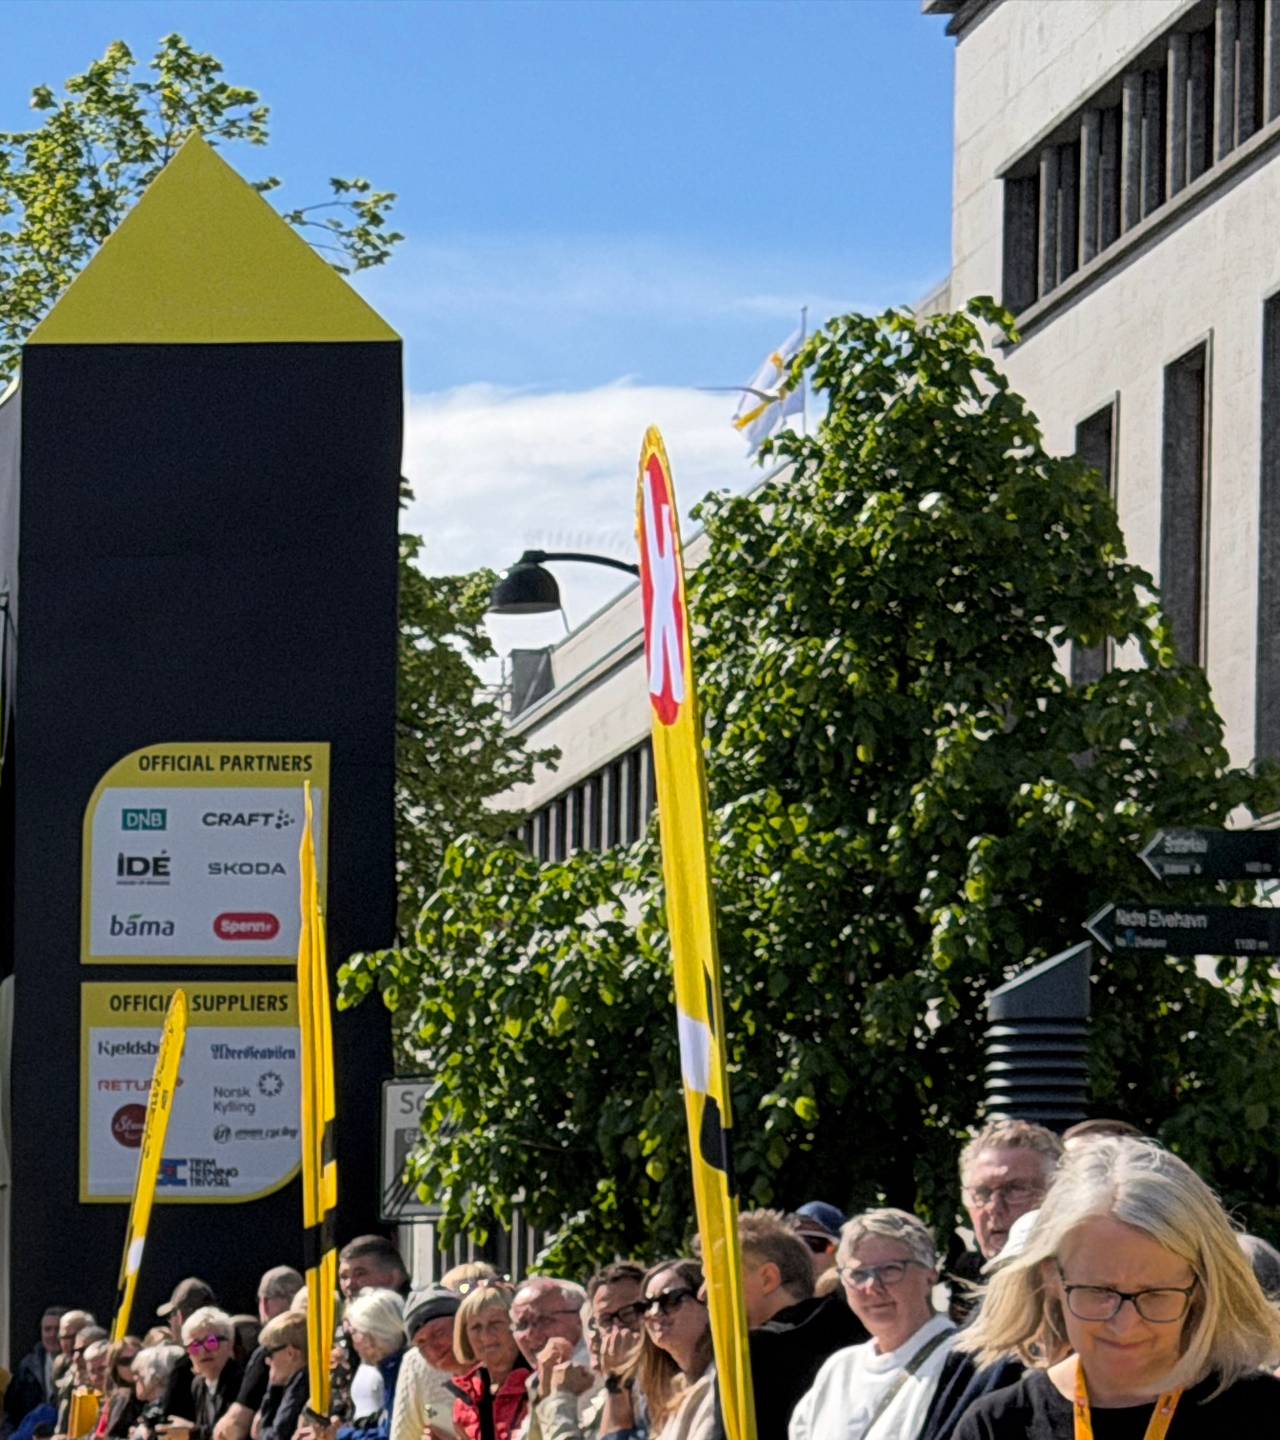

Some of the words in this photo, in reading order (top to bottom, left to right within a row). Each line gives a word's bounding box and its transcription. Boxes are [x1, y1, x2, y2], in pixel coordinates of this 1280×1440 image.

[138, 755, 215, 772] OFFICIAL
[219, 755, 313, 772] PARTNERS
[126, 812, 163, 828] DNB
[202, 811, 274, 827] CRAFT
[109, 995, 171, 1011] OFFICI
[191, 995, 289, 1011] SUPPLIERS
[98, 1042, 161, 1057] Kjeldsb
[213, 1087, 251, 1099] Norsk
[213, 1100, 257, 1116] Kylling
